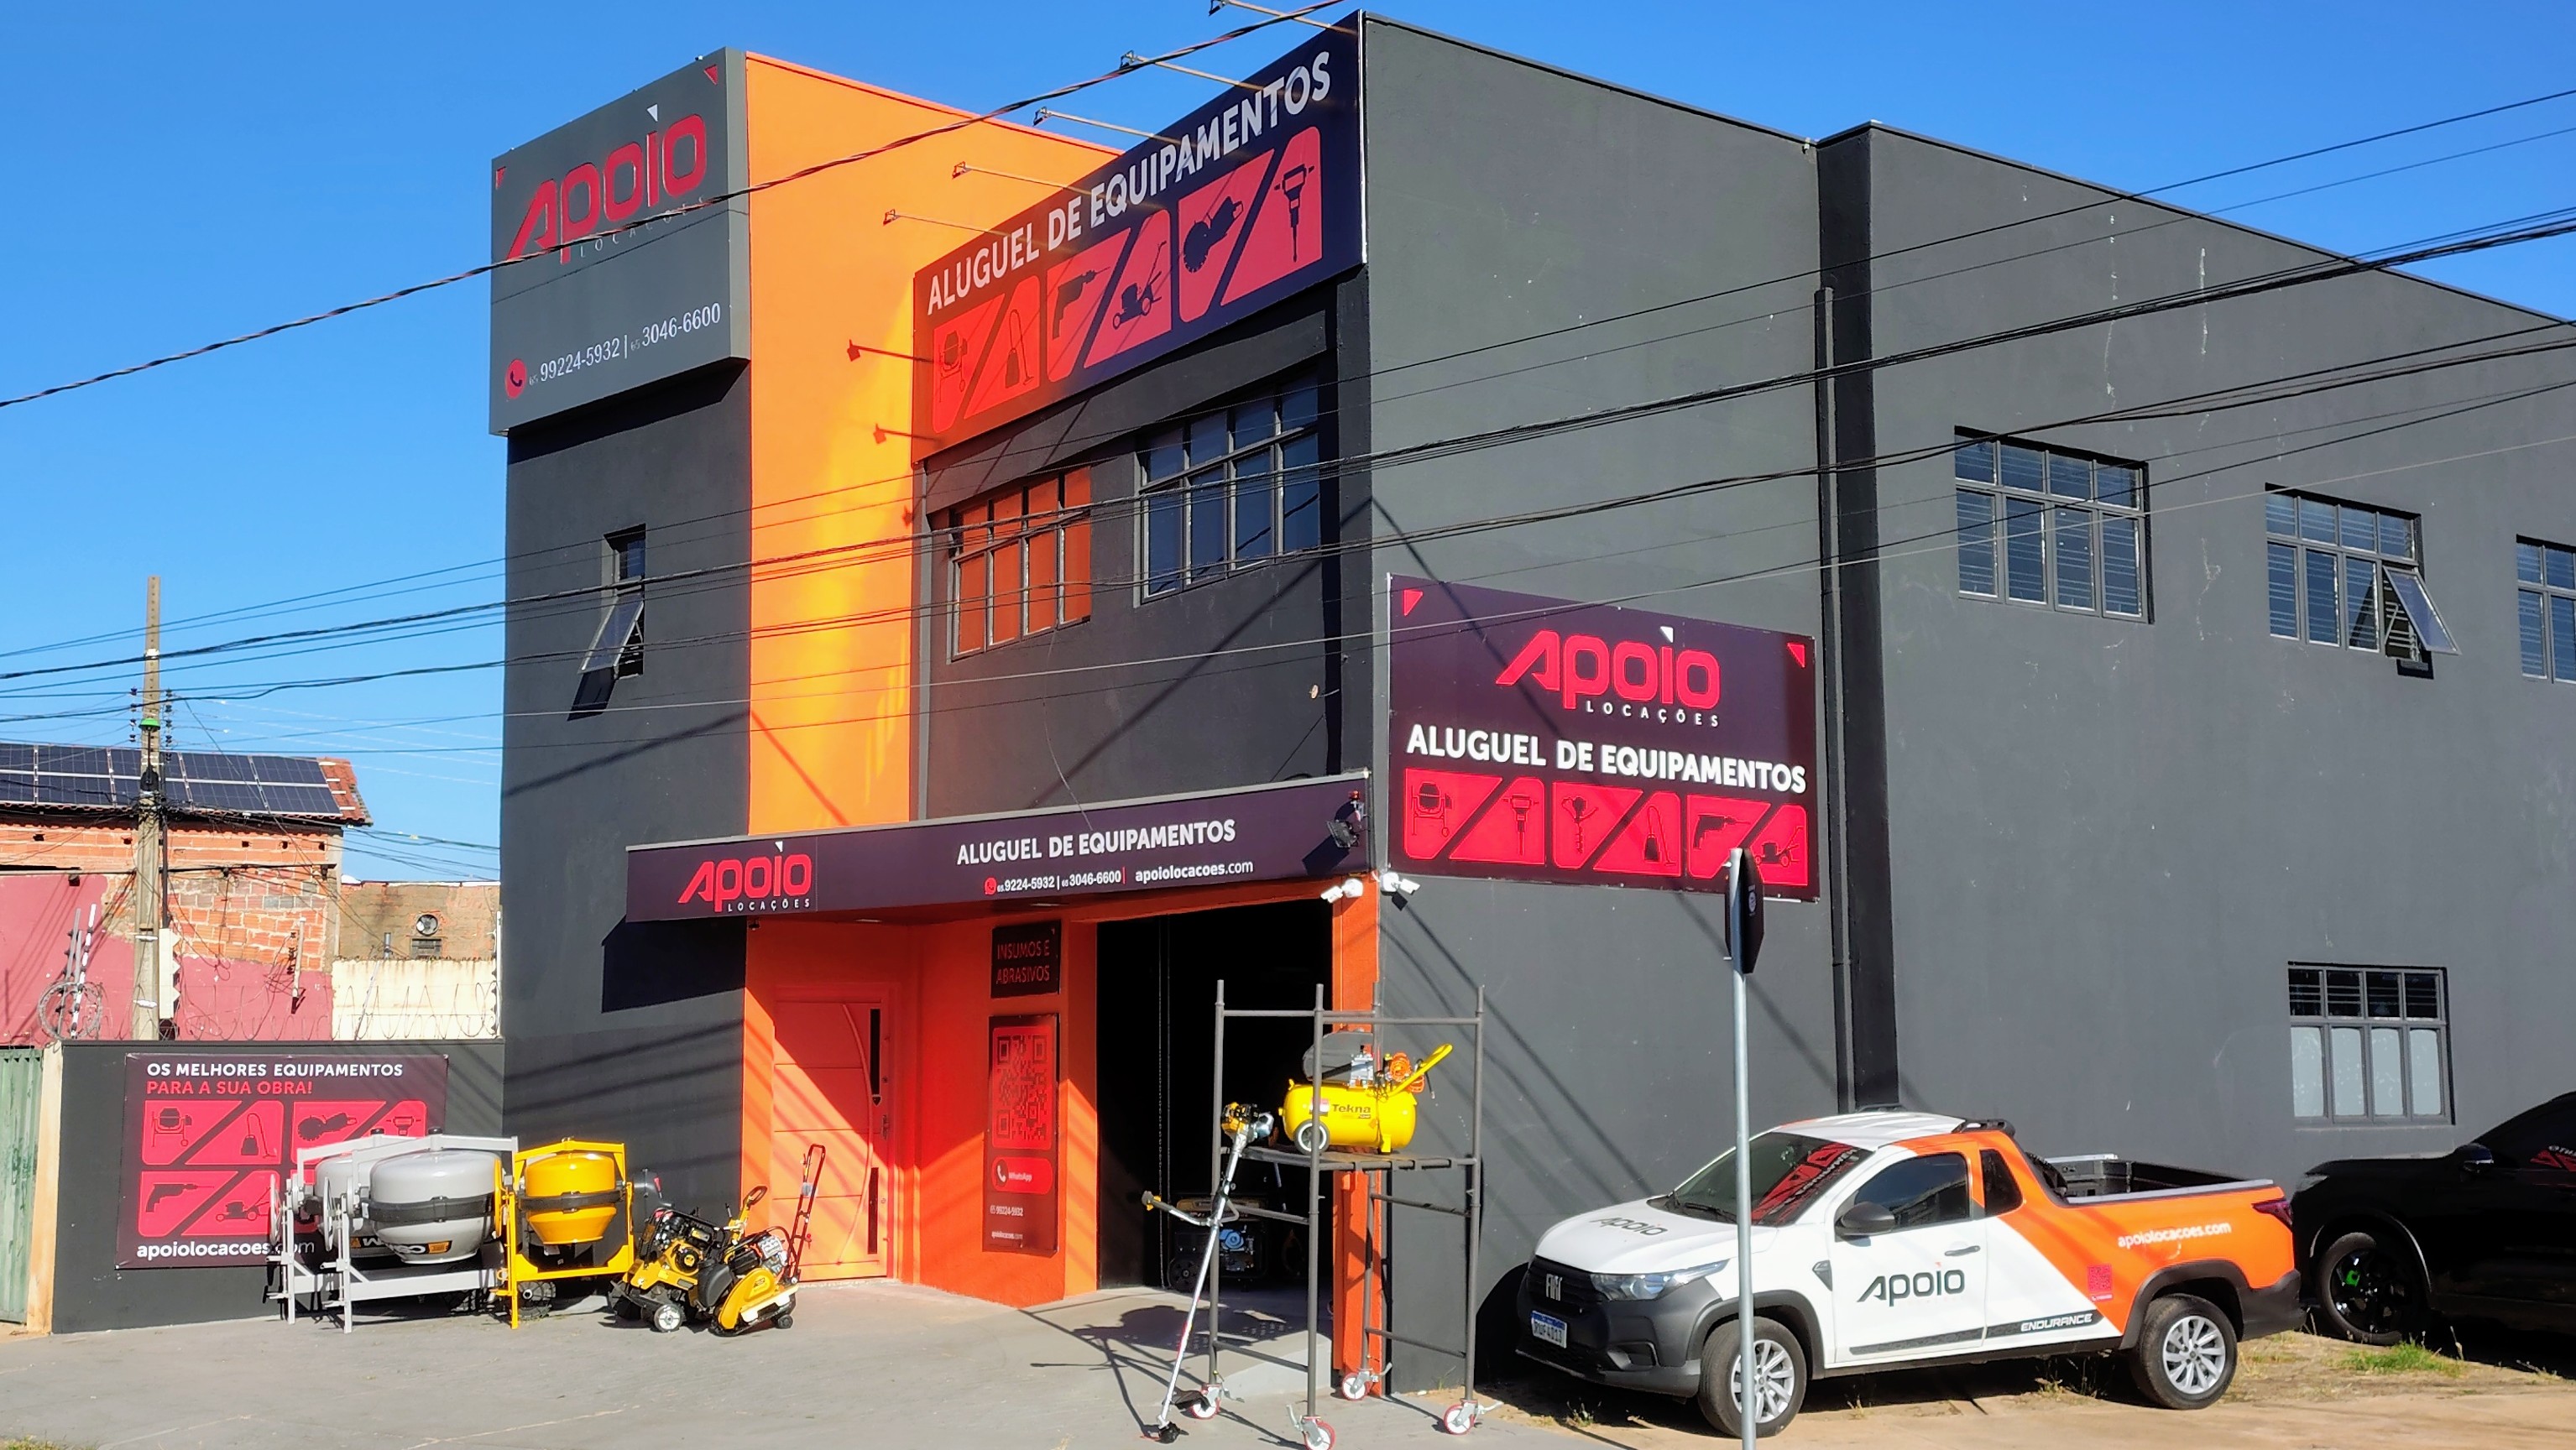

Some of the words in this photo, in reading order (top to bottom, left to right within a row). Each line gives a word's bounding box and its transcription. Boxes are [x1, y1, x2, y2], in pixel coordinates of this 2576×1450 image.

[927, 227, 1039, 315] ALUGUEL
[1048, 196, 1082, 252] DE
[1090, 51, 1332, 228] EQUIPAMENTOS
[540, 337, 620, 382] 99224-5932
[642, 302, 721, 347] 3046-6600
[1586, 700, 1720, 728] LOCAÇÕES
[1407, 723, 1546, 766] ALUGUEL
[1556, 739, 1594, 771] DE
[1601, 744, 1807, 794] EQUIPAMENTOS
[957, 837, 1042, 865] ALUGUEL
[1049, 835, 1074, 858] DE
[1079, 819, 1236, 855] EQUIPAMENTOS
[1069, 869, 1121, 887] 3046-6600
[1135, 861, 1254, 884] apoiolocacoes.com
[728, 898, 811, 913] LOCAÇÕES
[996, 940, 1042, 960] INSUMOS
[1043, 939, 1050, 957] E
[995, 964, 1050, 985] ABRASIVOS
[147, 1063, 170, 1077] OS
[175, 1063, 267, 1077] MELHORES
[274, 1063, 403, 1077] EQUIPAMENTOS
[146, 1081, 194, 1095] PARA
[198, 1081, 212, 1095] A
[217, 1081, 252, 1095] SUA
[257, 1081, 312, 1095] OBRA!
[1331, 1103, 1372, 1114] Tekna
[2118, 1222, 2232, 1249] apoiolocacoes.com
[137, 1241, 315, 1260] apoiolocacoes.cm
[2020, 1312, 2093, 1333] ENDURANCE
